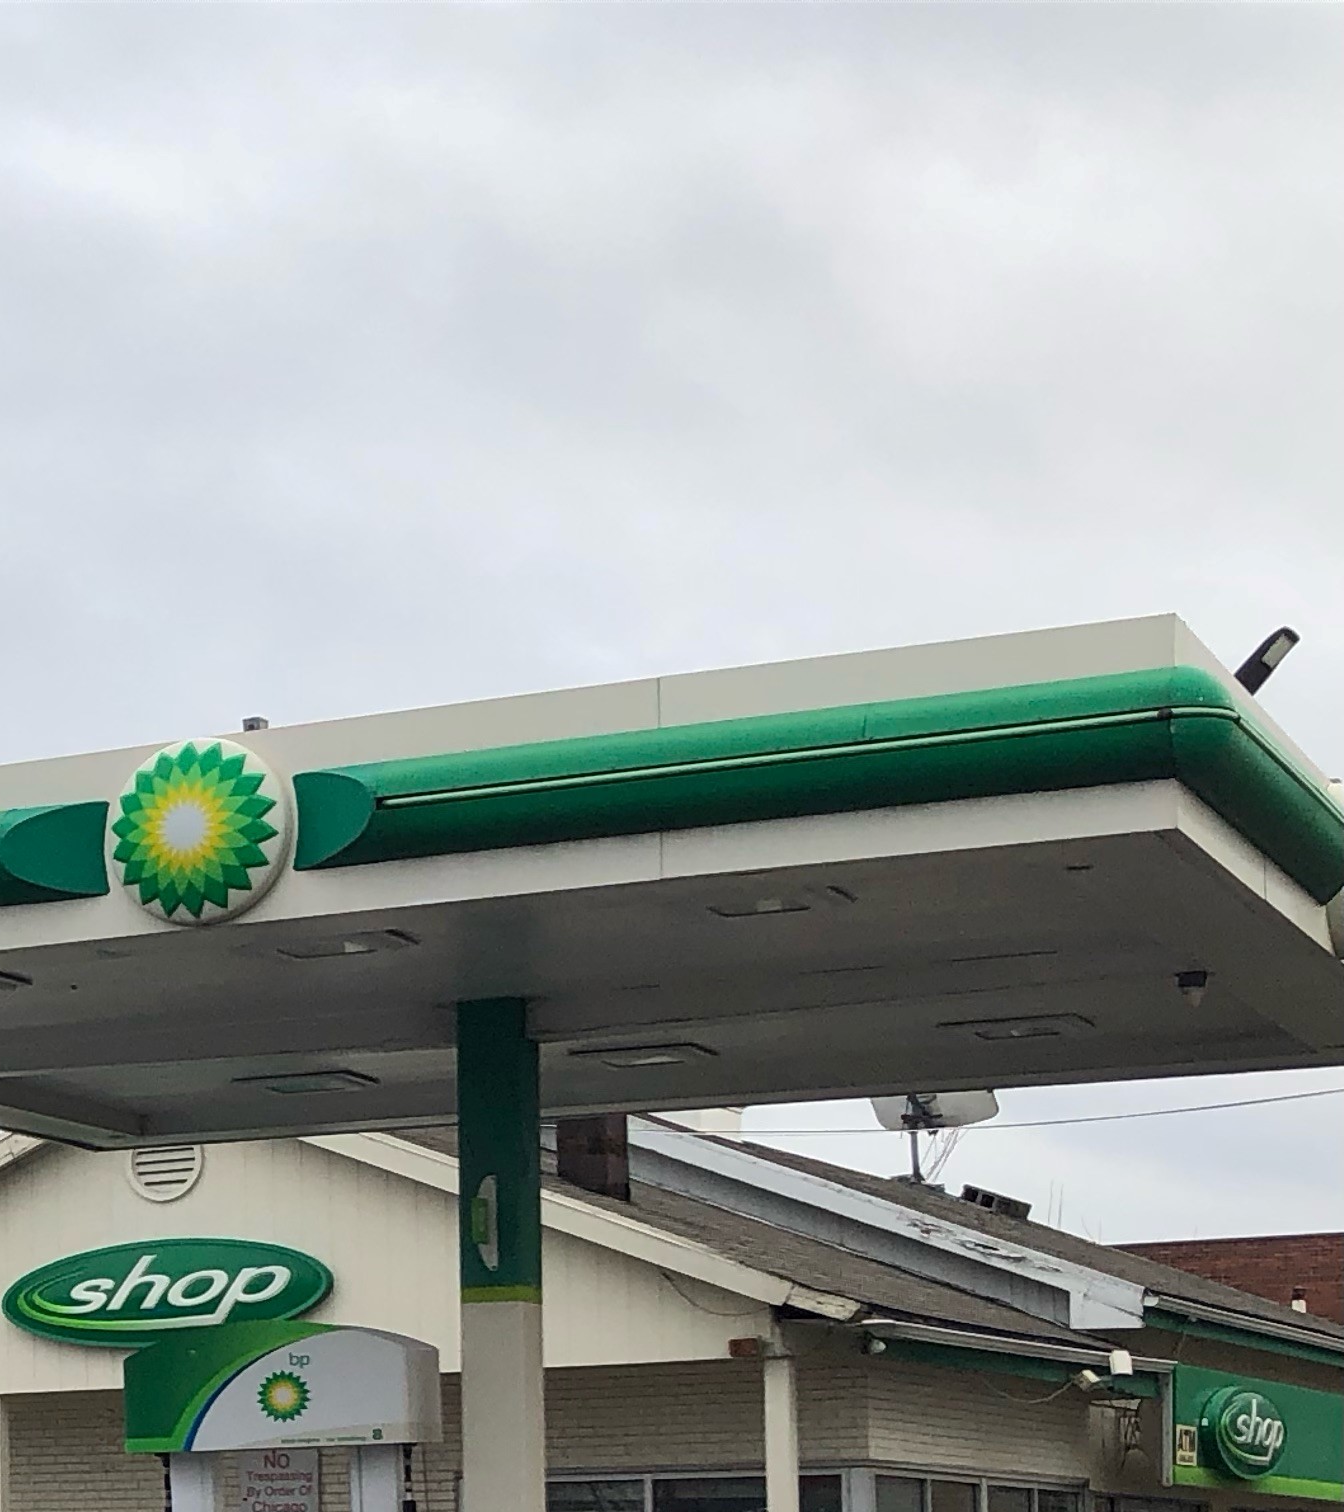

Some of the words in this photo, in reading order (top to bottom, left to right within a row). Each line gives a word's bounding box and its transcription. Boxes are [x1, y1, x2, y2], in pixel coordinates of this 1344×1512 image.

[68, 1253, 292, 1325] shop
[288, 1352, 310, 1369] bp
[1234, 1398, 1285, 1464] shop
[263, 1452, 290, 1469] NO
[246, 1486, 261, 1498] By
